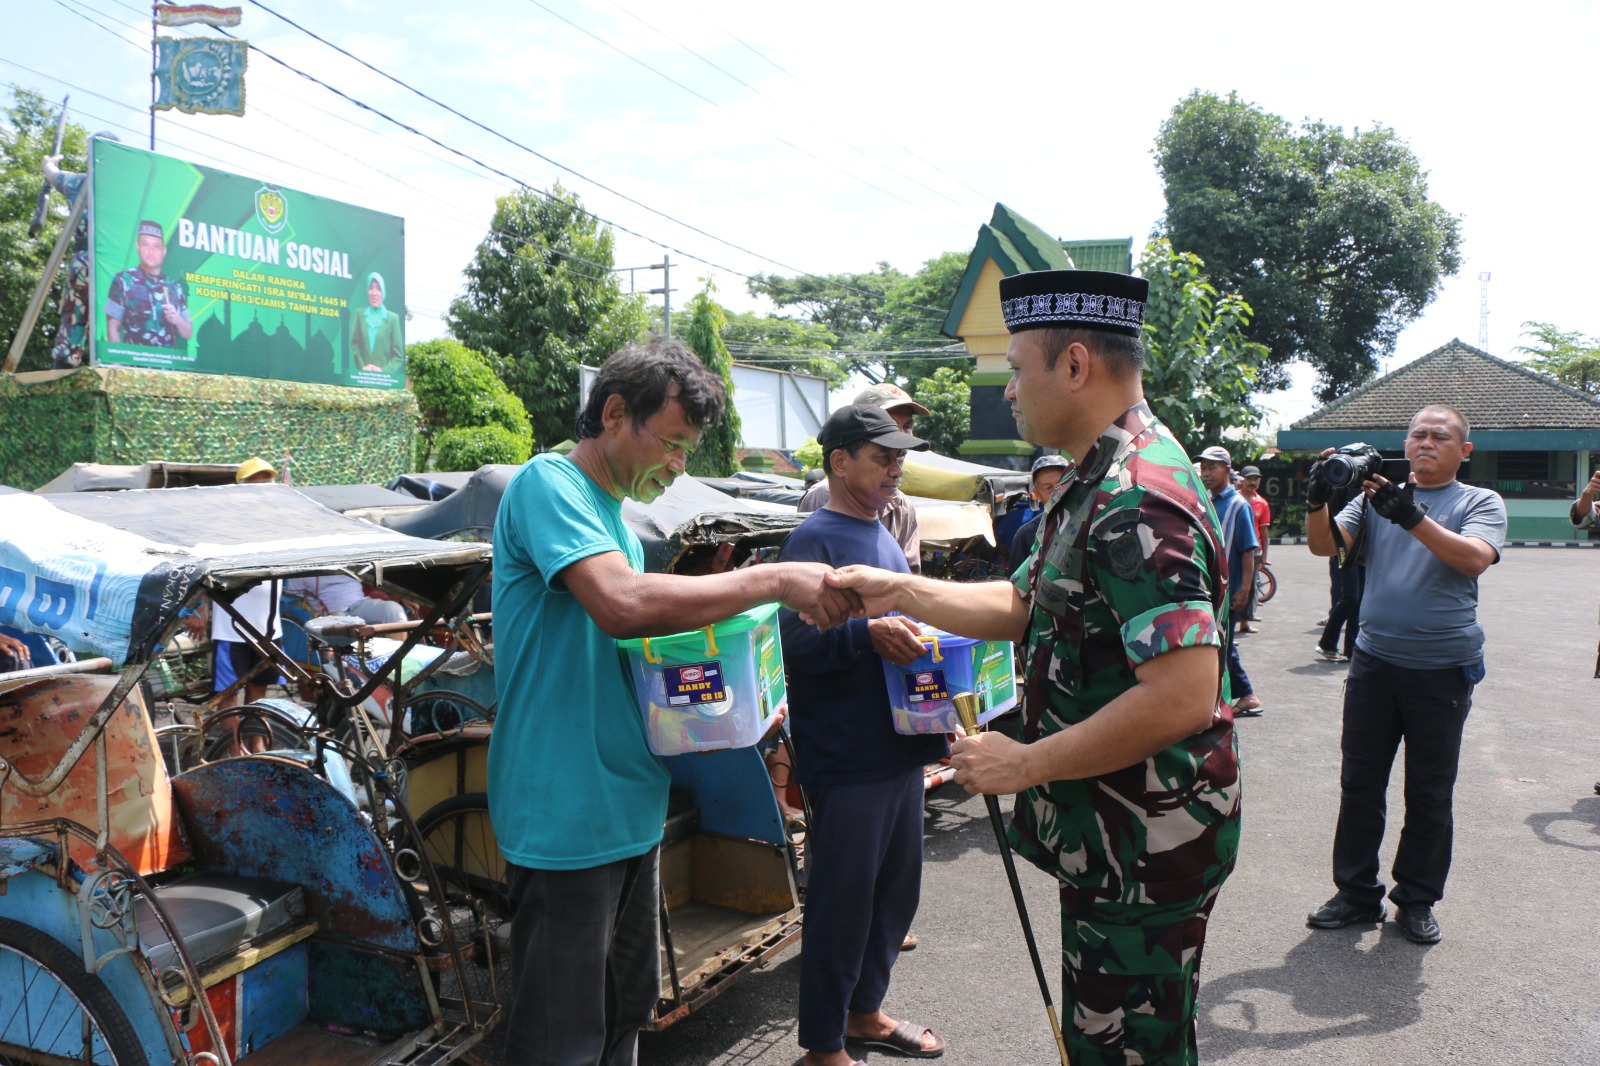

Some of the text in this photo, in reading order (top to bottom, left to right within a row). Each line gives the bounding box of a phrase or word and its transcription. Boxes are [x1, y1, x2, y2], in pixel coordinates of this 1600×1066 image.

[179, 218, 352, 279] BANTUAN SOSIAL
[185, 272, 347, 308] MEMPERINGATI ISRA MI'RAJ 1445 H
[232, 268, 306, 290] DALAM RANGKA
[195, 286, 340, 318] KODIM 0613/CIAMIS TAHUN 2024
[678, 682, 712, 692] HANDY
